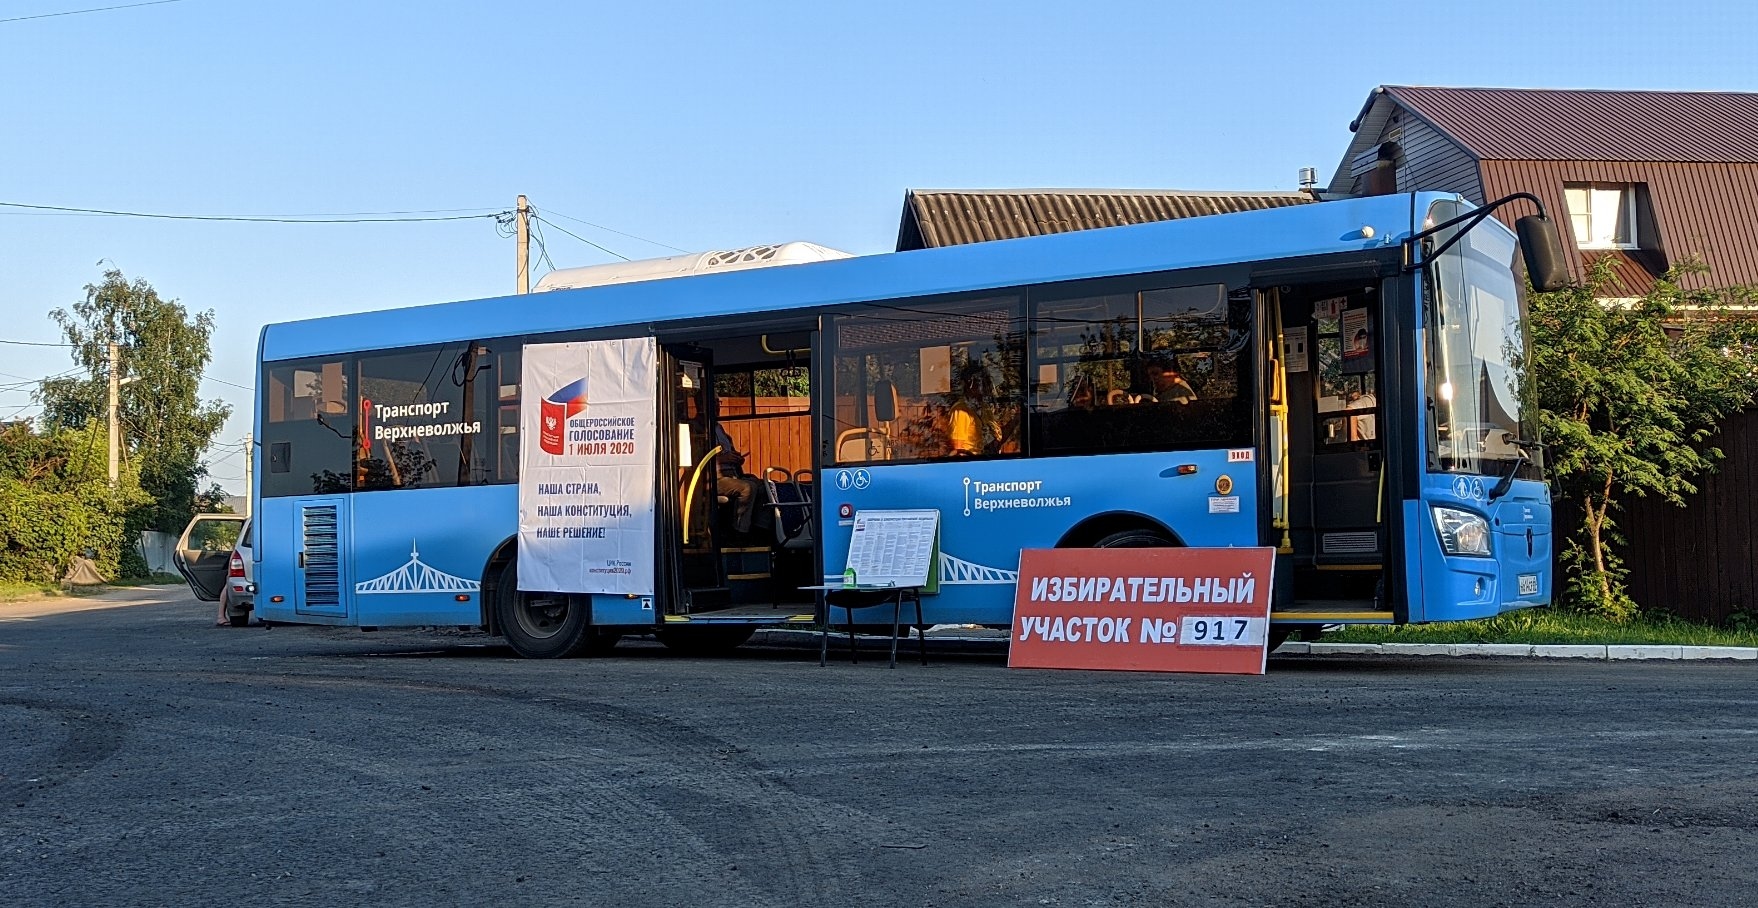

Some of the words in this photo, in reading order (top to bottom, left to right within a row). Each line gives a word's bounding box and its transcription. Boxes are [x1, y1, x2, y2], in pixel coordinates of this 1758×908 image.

[374, 402, 450, 422] Транспорт
[569, 416, 635, 429] ОБЩЕРОССИЙСКОЕ
[375, 421, 481, 443] Верхневолжья
[569, 428, 635, 442] ГОЛОСОВАНИЕ
[569, 443, 574, 456] 1
[577, 442, 607, 456] ИЮЛЯ
[609, 441, 634, 455] 2020
[1231, 451, 1250, 460] ВХОД
[538, 483, 563, 495] НАША
[566, 482, 602, 496] СТРАНА,
[974, 480, 1042, 496] Транспорт
[537, 505, 562, 517] НАША
[565, 504, 632, 518] КОНСТИТУЦИЯ,
[974, 496, 1071, 512] Верхневолжья
[536, 527, 561, 538] НАШЕ
[562, 526, 606, 539] РЕШЕНИЕ!
[1030, 572, 1256, 604] ИЗБИРАТЕЛЬНЫЙ
[1019, 615, 1132, 643] УЧАСТОК
[1139, 618, 1177, 643] №
[1193, 619, 1248, 641] 917
